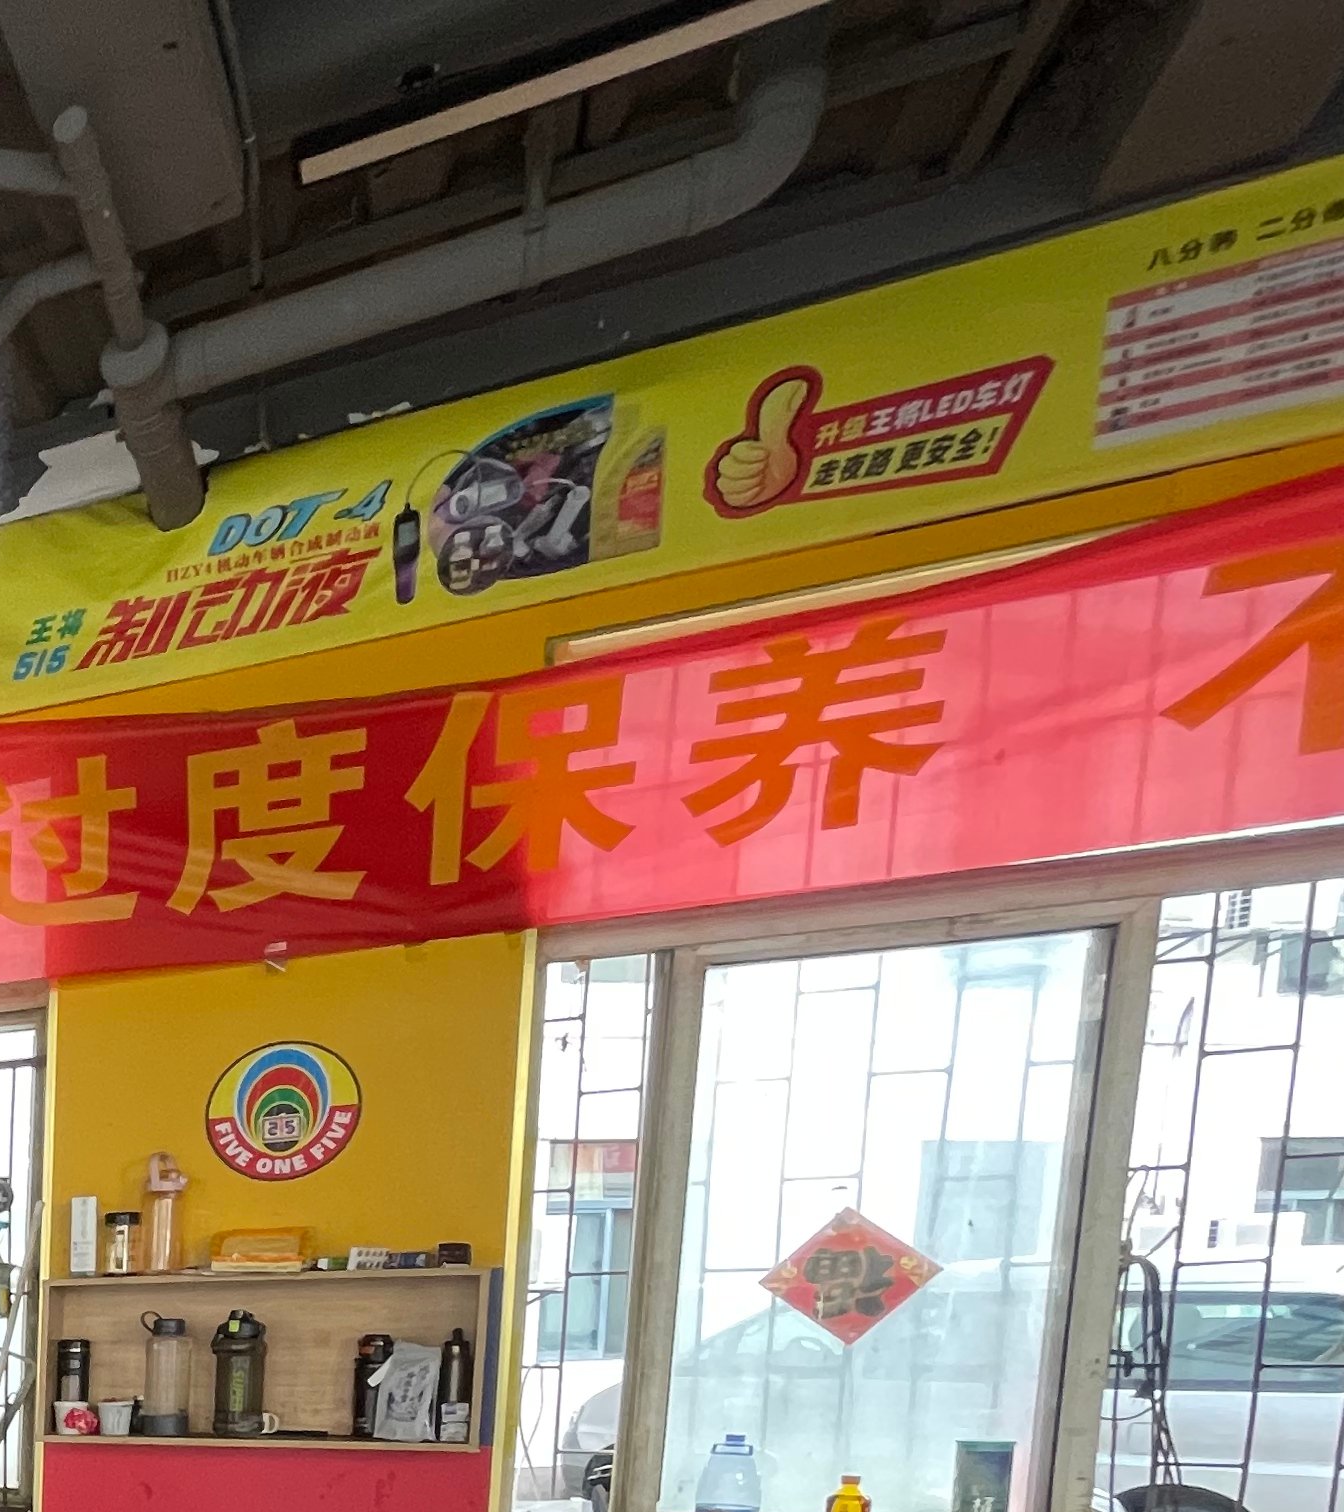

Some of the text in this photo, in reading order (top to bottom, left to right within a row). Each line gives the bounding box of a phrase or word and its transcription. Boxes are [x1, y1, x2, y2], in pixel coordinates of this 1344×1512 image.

[71, 546, 383, 672] 制动液
[12, 645, 71, 681] 515
[214, 1110, 353, 1175] FIVE ONE FIVE
